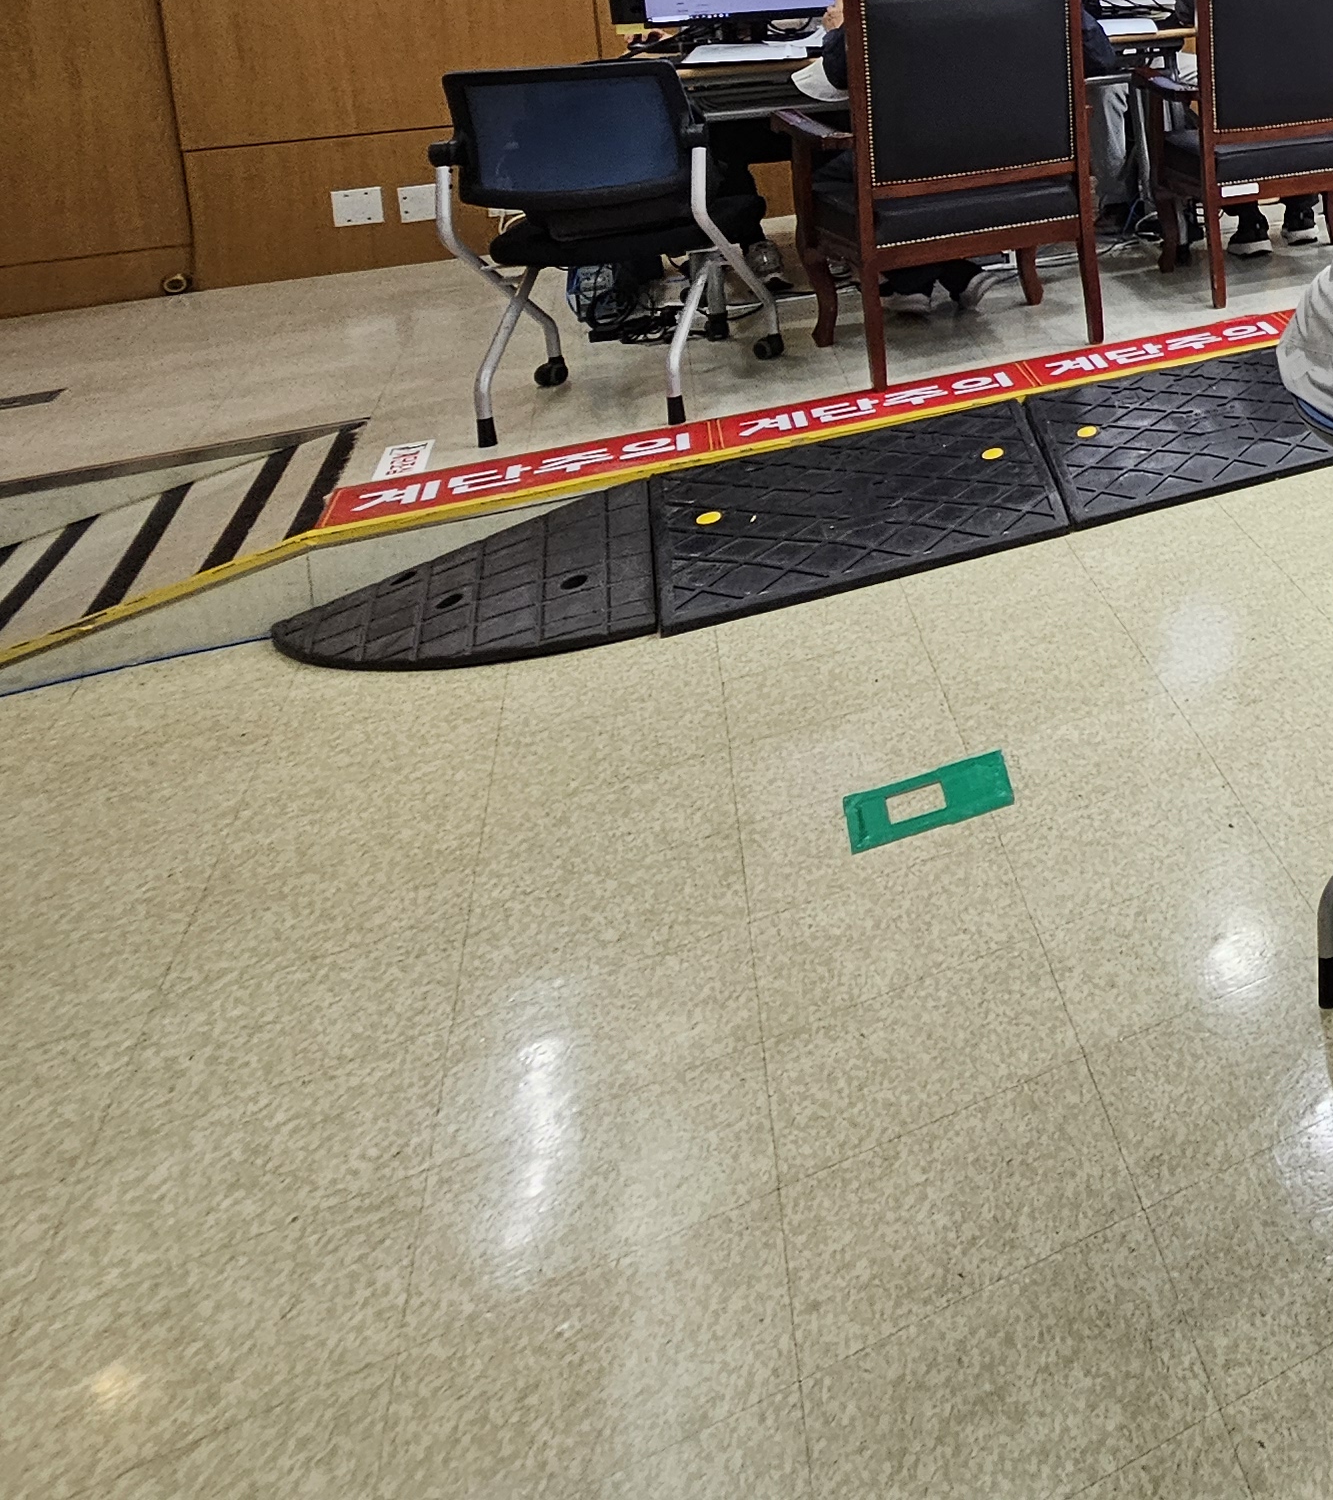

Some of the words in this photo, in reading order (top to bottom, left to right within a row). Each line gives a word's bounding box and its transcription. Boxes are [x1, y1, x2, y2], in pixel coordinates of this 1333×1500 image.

[1044, 320, 1280, 378] 계단주의
[738, 371, 1016, 438] 계단주의
[349, 431, 693, 512] 계단주의
